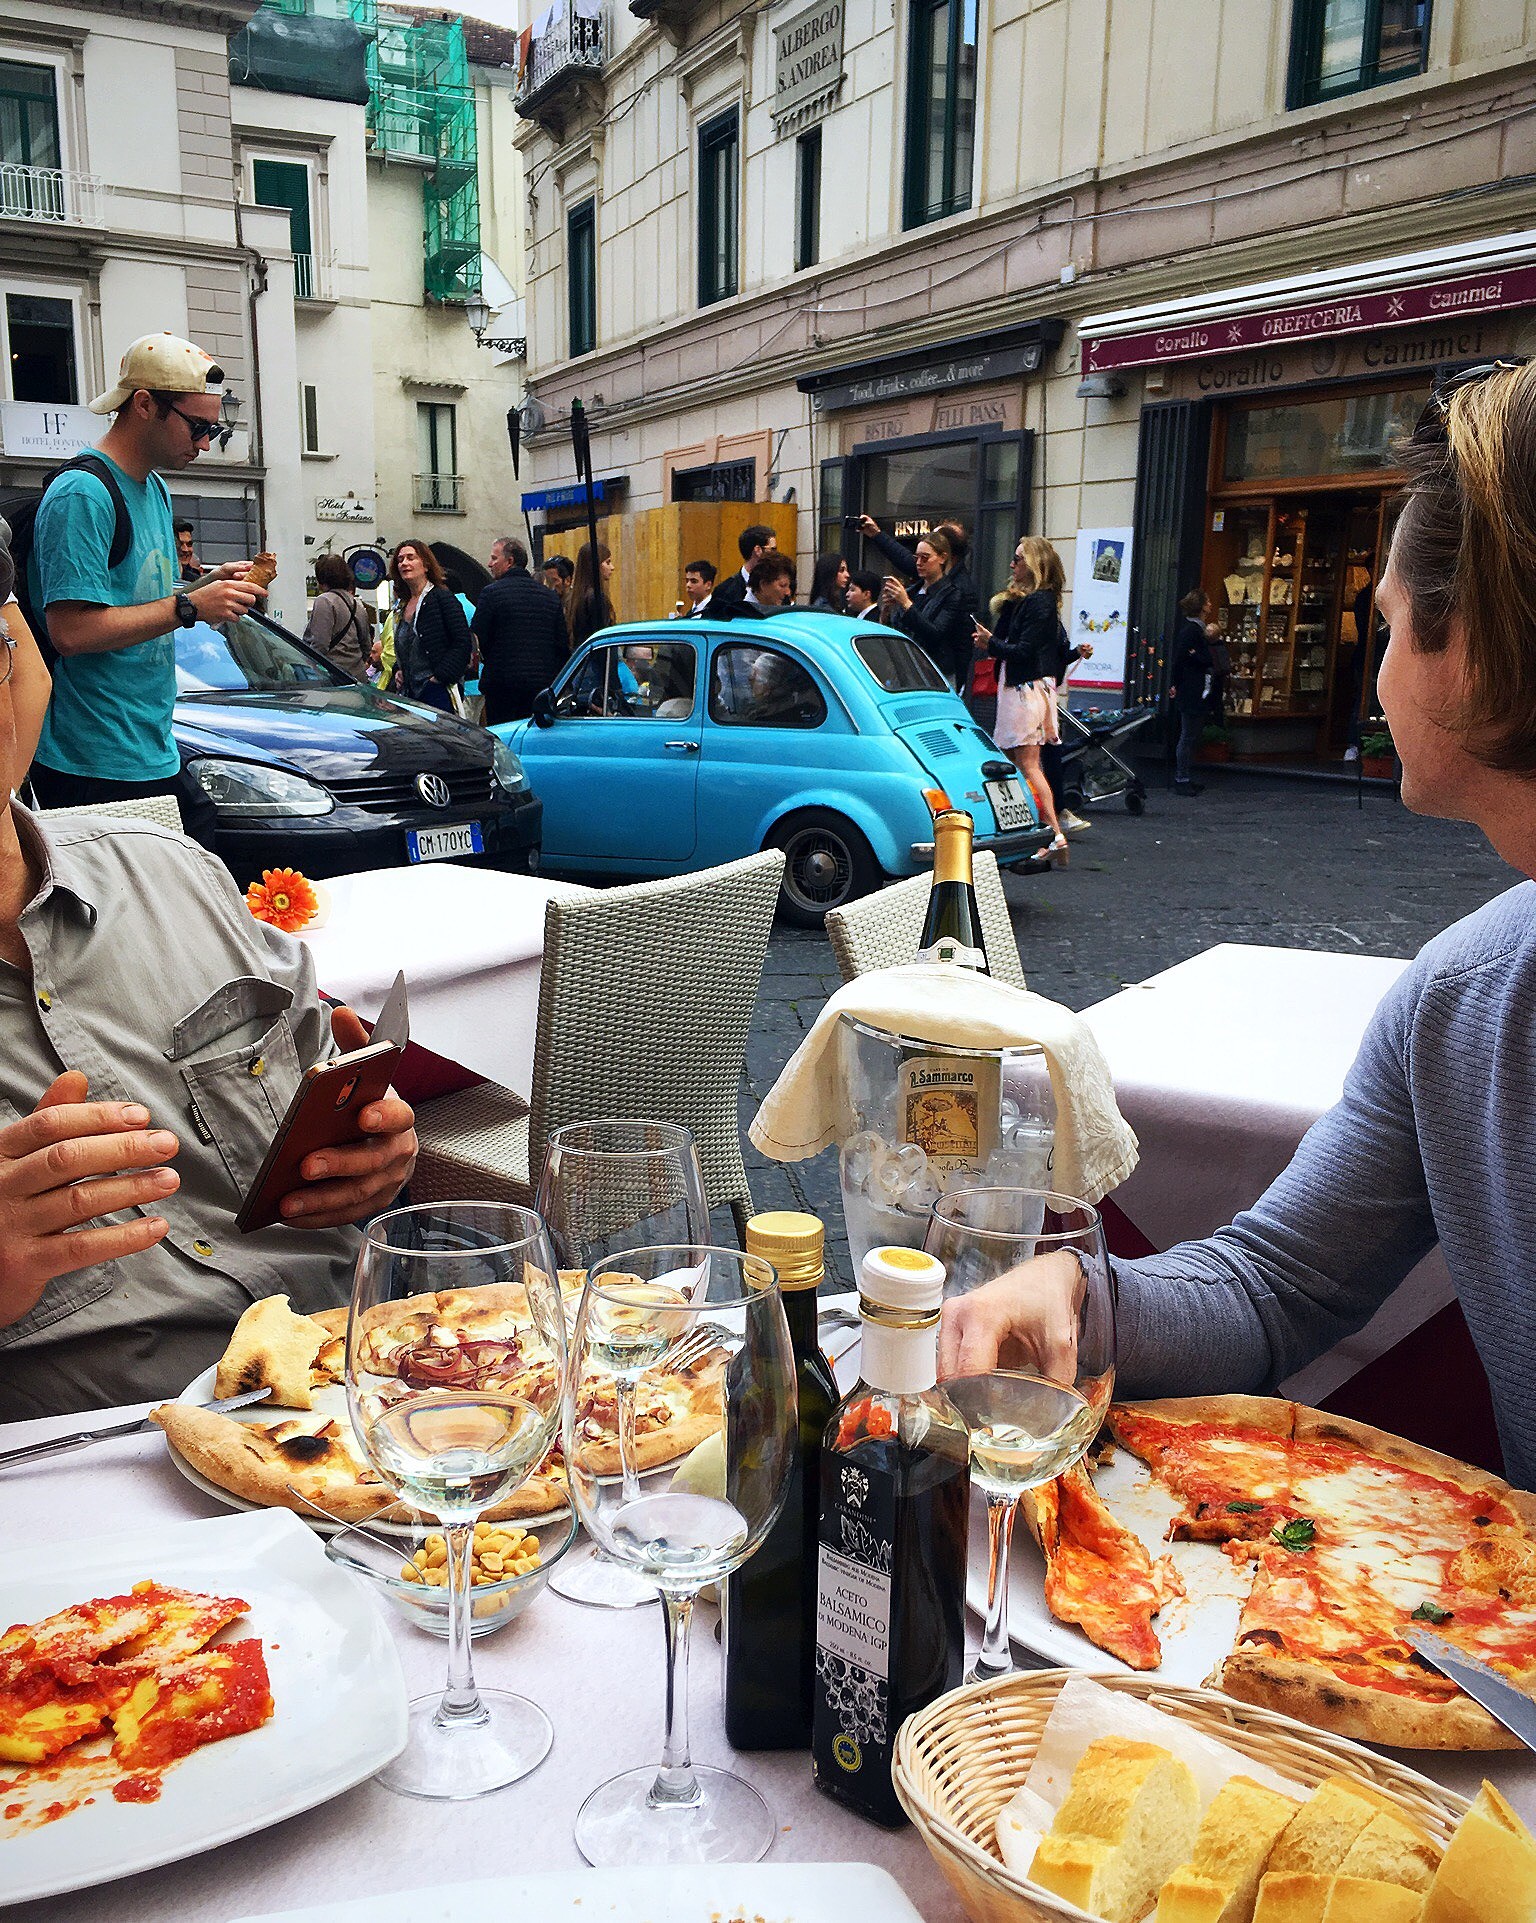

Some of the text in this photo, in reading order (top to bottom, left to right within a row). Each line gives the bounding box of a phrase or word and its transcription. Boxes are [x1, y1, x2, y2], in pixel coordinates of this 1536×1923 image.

[779, 5, 840, 61] ALBERGO
[1429, 281, 1502, 309] Cammei
[1262, 304, 1363, 337] OREFICERIA
[1155, 332, 1209, 353] Corallo
[1364, 327, 1484, 367] Cammei
[1197, 358, 1283, 391] Corallo
[22, 436, 50, 446] HOTEL
[318, 498, 345, 509] Hotel
[336, 509, 373, 521] Fontana
[835, 1586, 868, 1608] ACETO
[819, 1592, 887, 1634] BALSAMICO
[827, 1615, 869, 1644] MODENA
[870, 1635, 887, 1651] IGP
